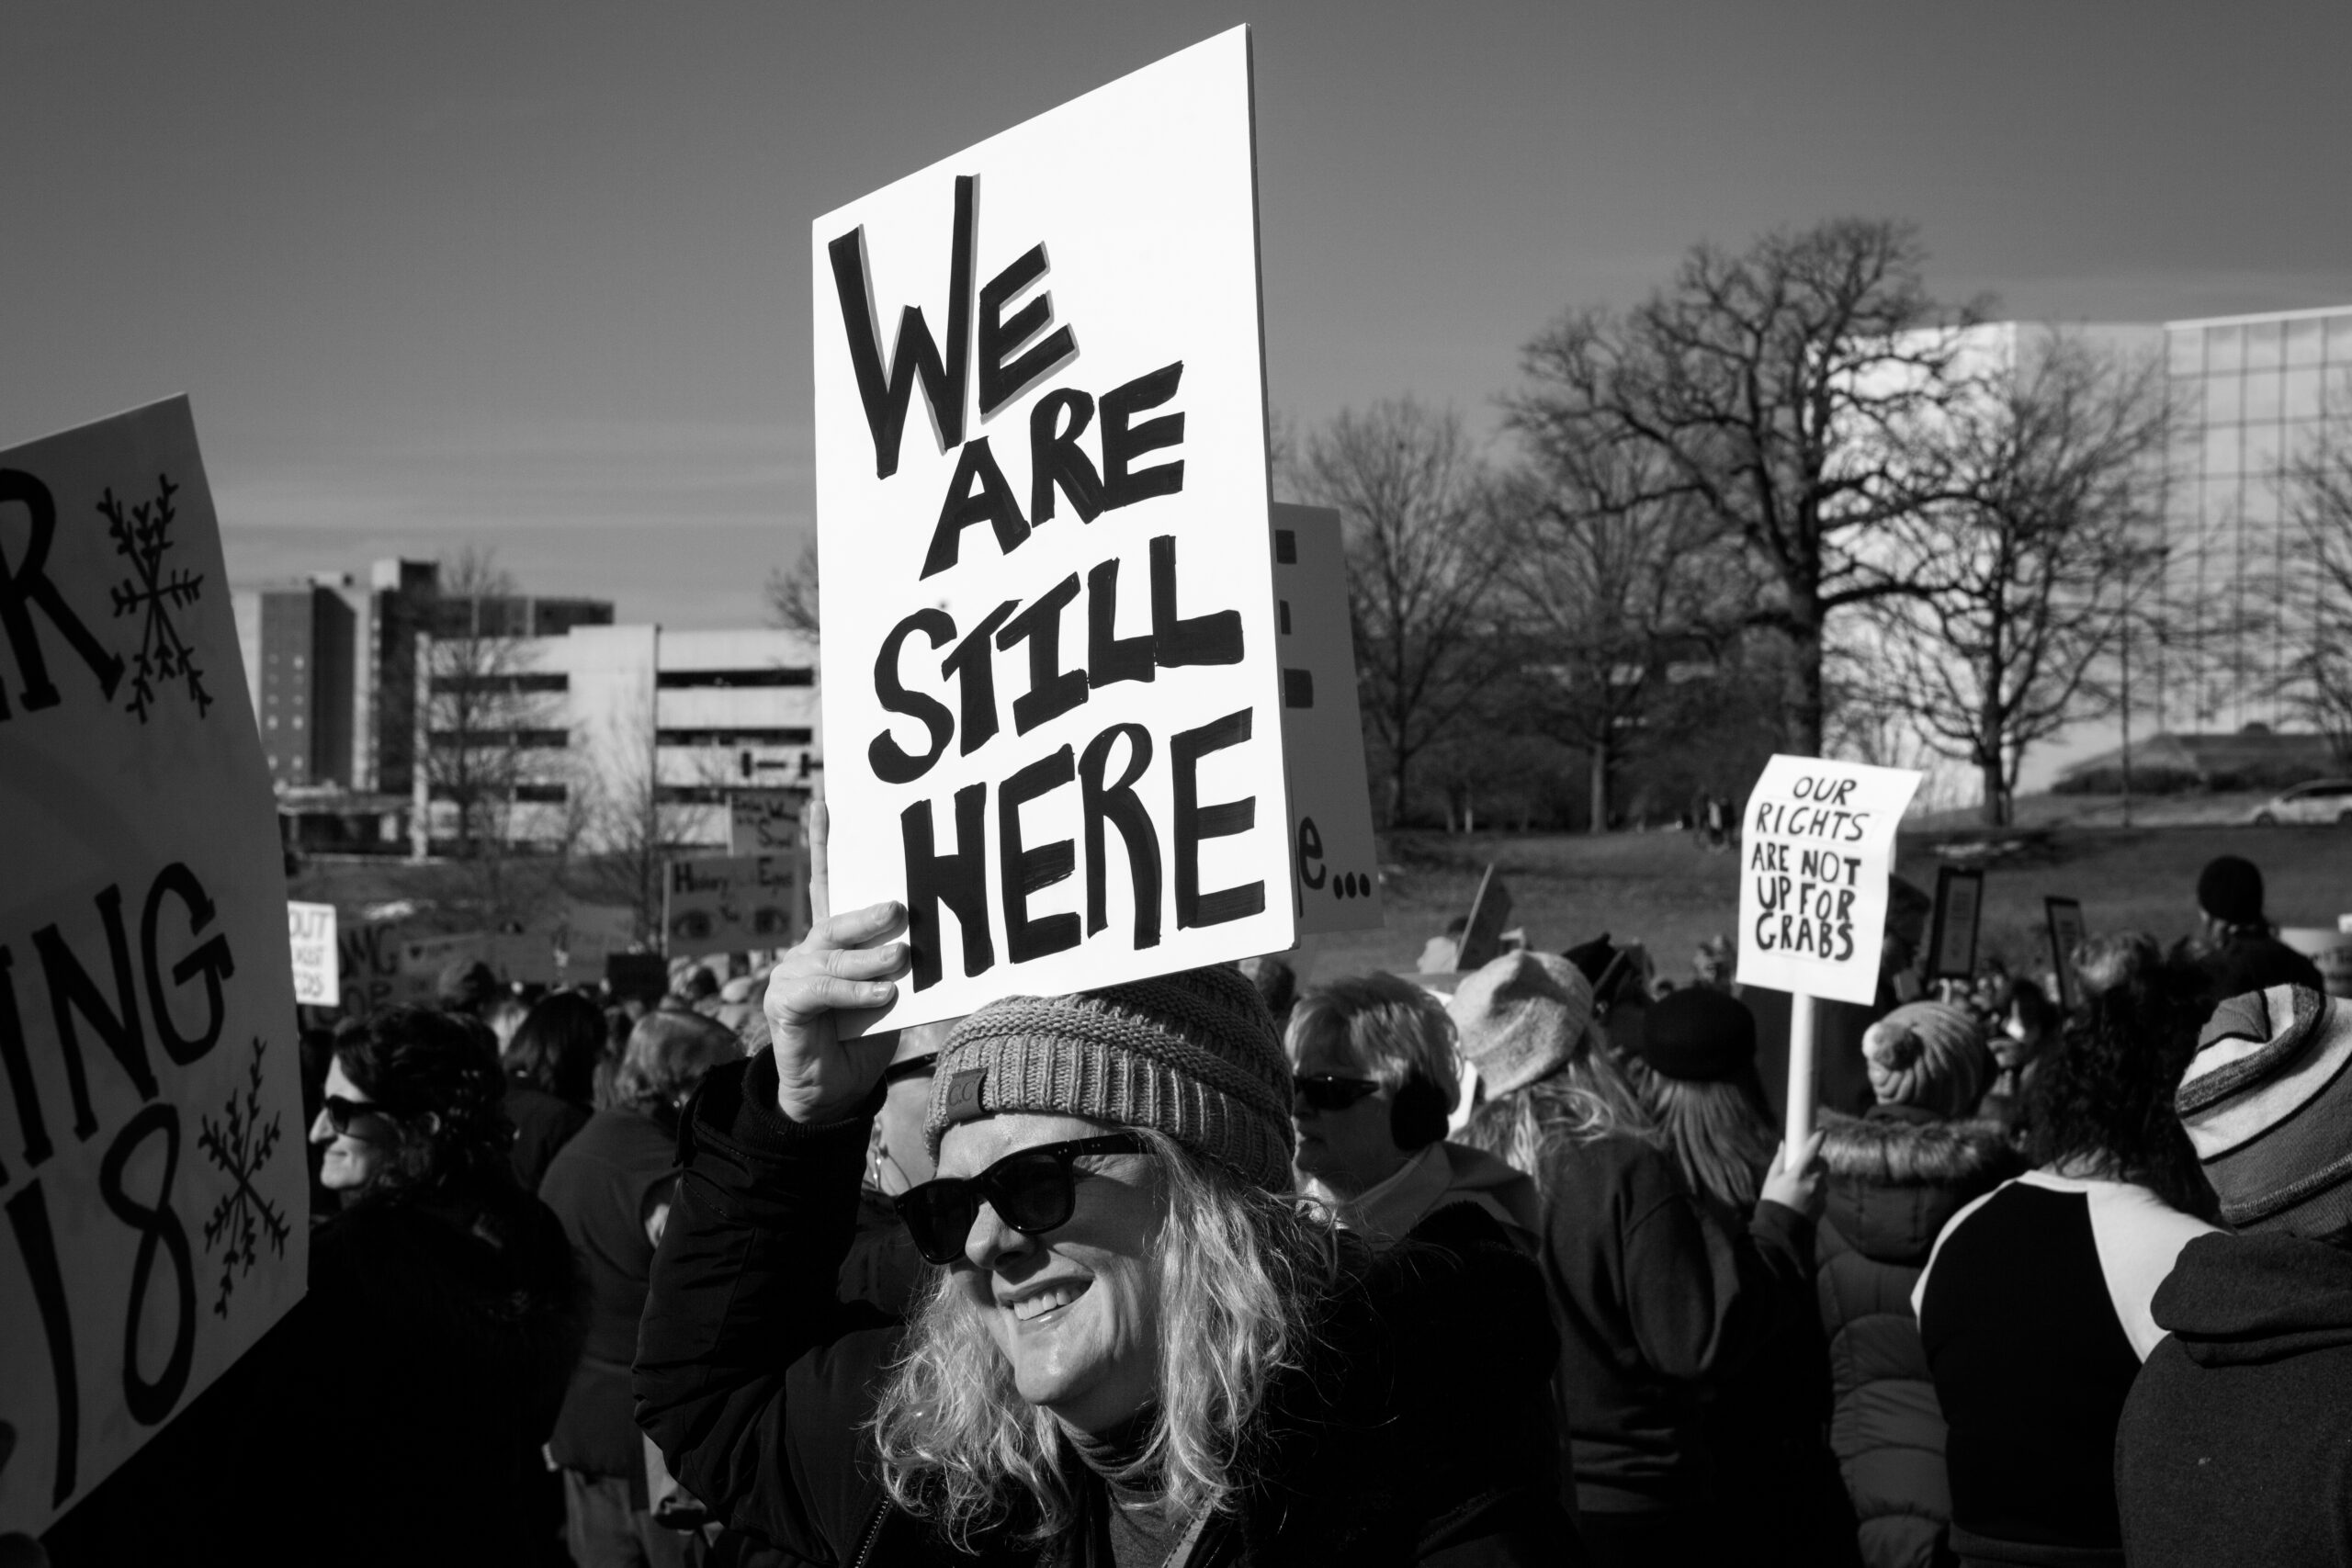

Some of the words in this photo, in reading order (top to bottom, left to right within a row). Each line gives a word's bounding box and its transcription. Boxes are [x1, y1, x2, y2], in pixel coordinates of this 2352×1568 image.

[828, 173, 1080, 479] WE
[919, 360, 1185, 581] ARE
[0, 468, 125, 720] R
[868, 535, 1244, 784] STILL
[900, 706, 1266, 993] HERE
[1751, 842, 1789, 872] ARE
[1801, 850, 1860, 886] NOT
[1756, 802, 1870, 841] RIGHTS
[1758, 875, 1792, 910] UP
[1799, 883, 1856, 921] FOR
[1793, 776, 1857, 806] OUR
[0, 863, 235, 1180] ING
[1756, 911, 1854, 961] GRABS
